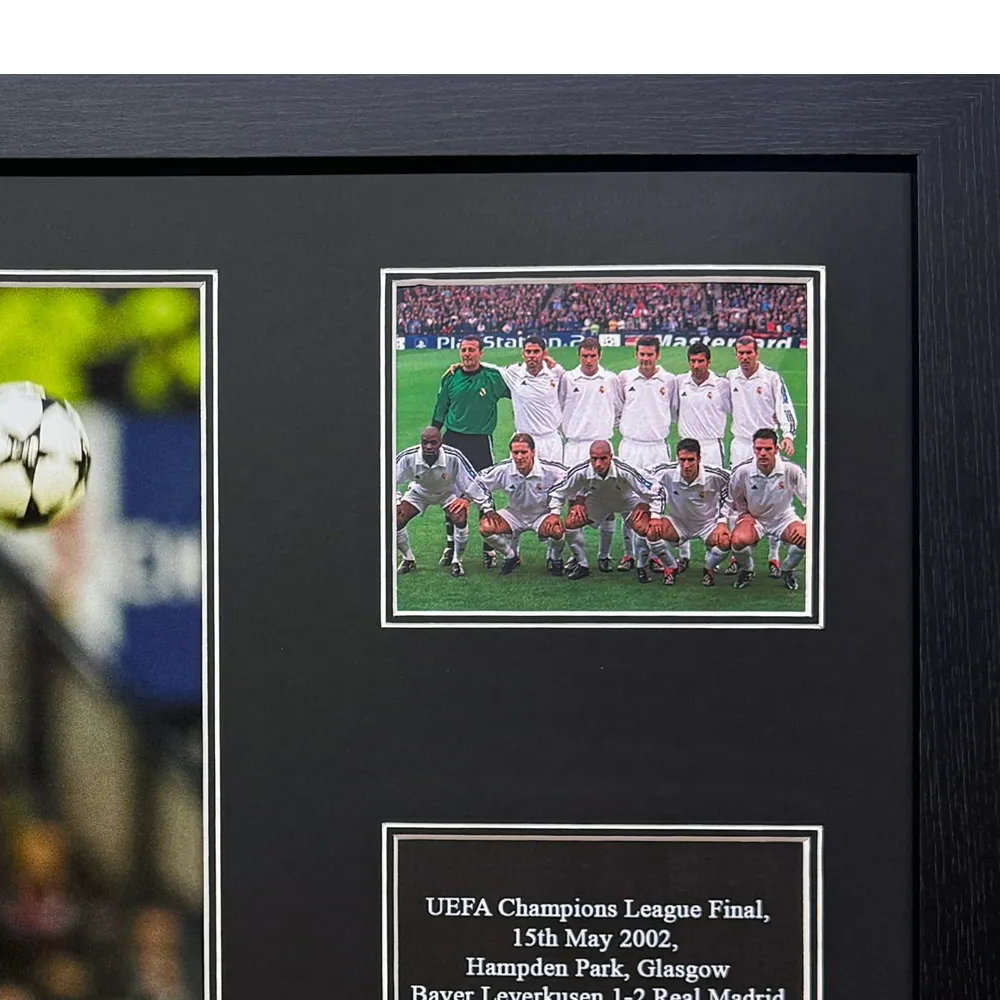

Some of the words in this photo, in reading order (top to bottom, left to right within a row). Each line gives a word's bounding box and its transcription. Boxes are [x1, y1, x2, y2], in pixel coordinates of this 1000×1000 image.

[654, 333, 793, 349] Masterard
[426, 897, 493, 917] UEFA
[498, 897, 618, 923] Champions
[623, 899, 702, 924] League
[708, 899, 770, 923] Final,
[513, 928, 559, 947] 15th
[565, 928, 614, 953] May
[619, 929, 679, 952] 2002,
[465, 956, 569, 982] Hampden
[574, 957, 630, 982] Park,
[636, 959, 731, 984] Glasgow
